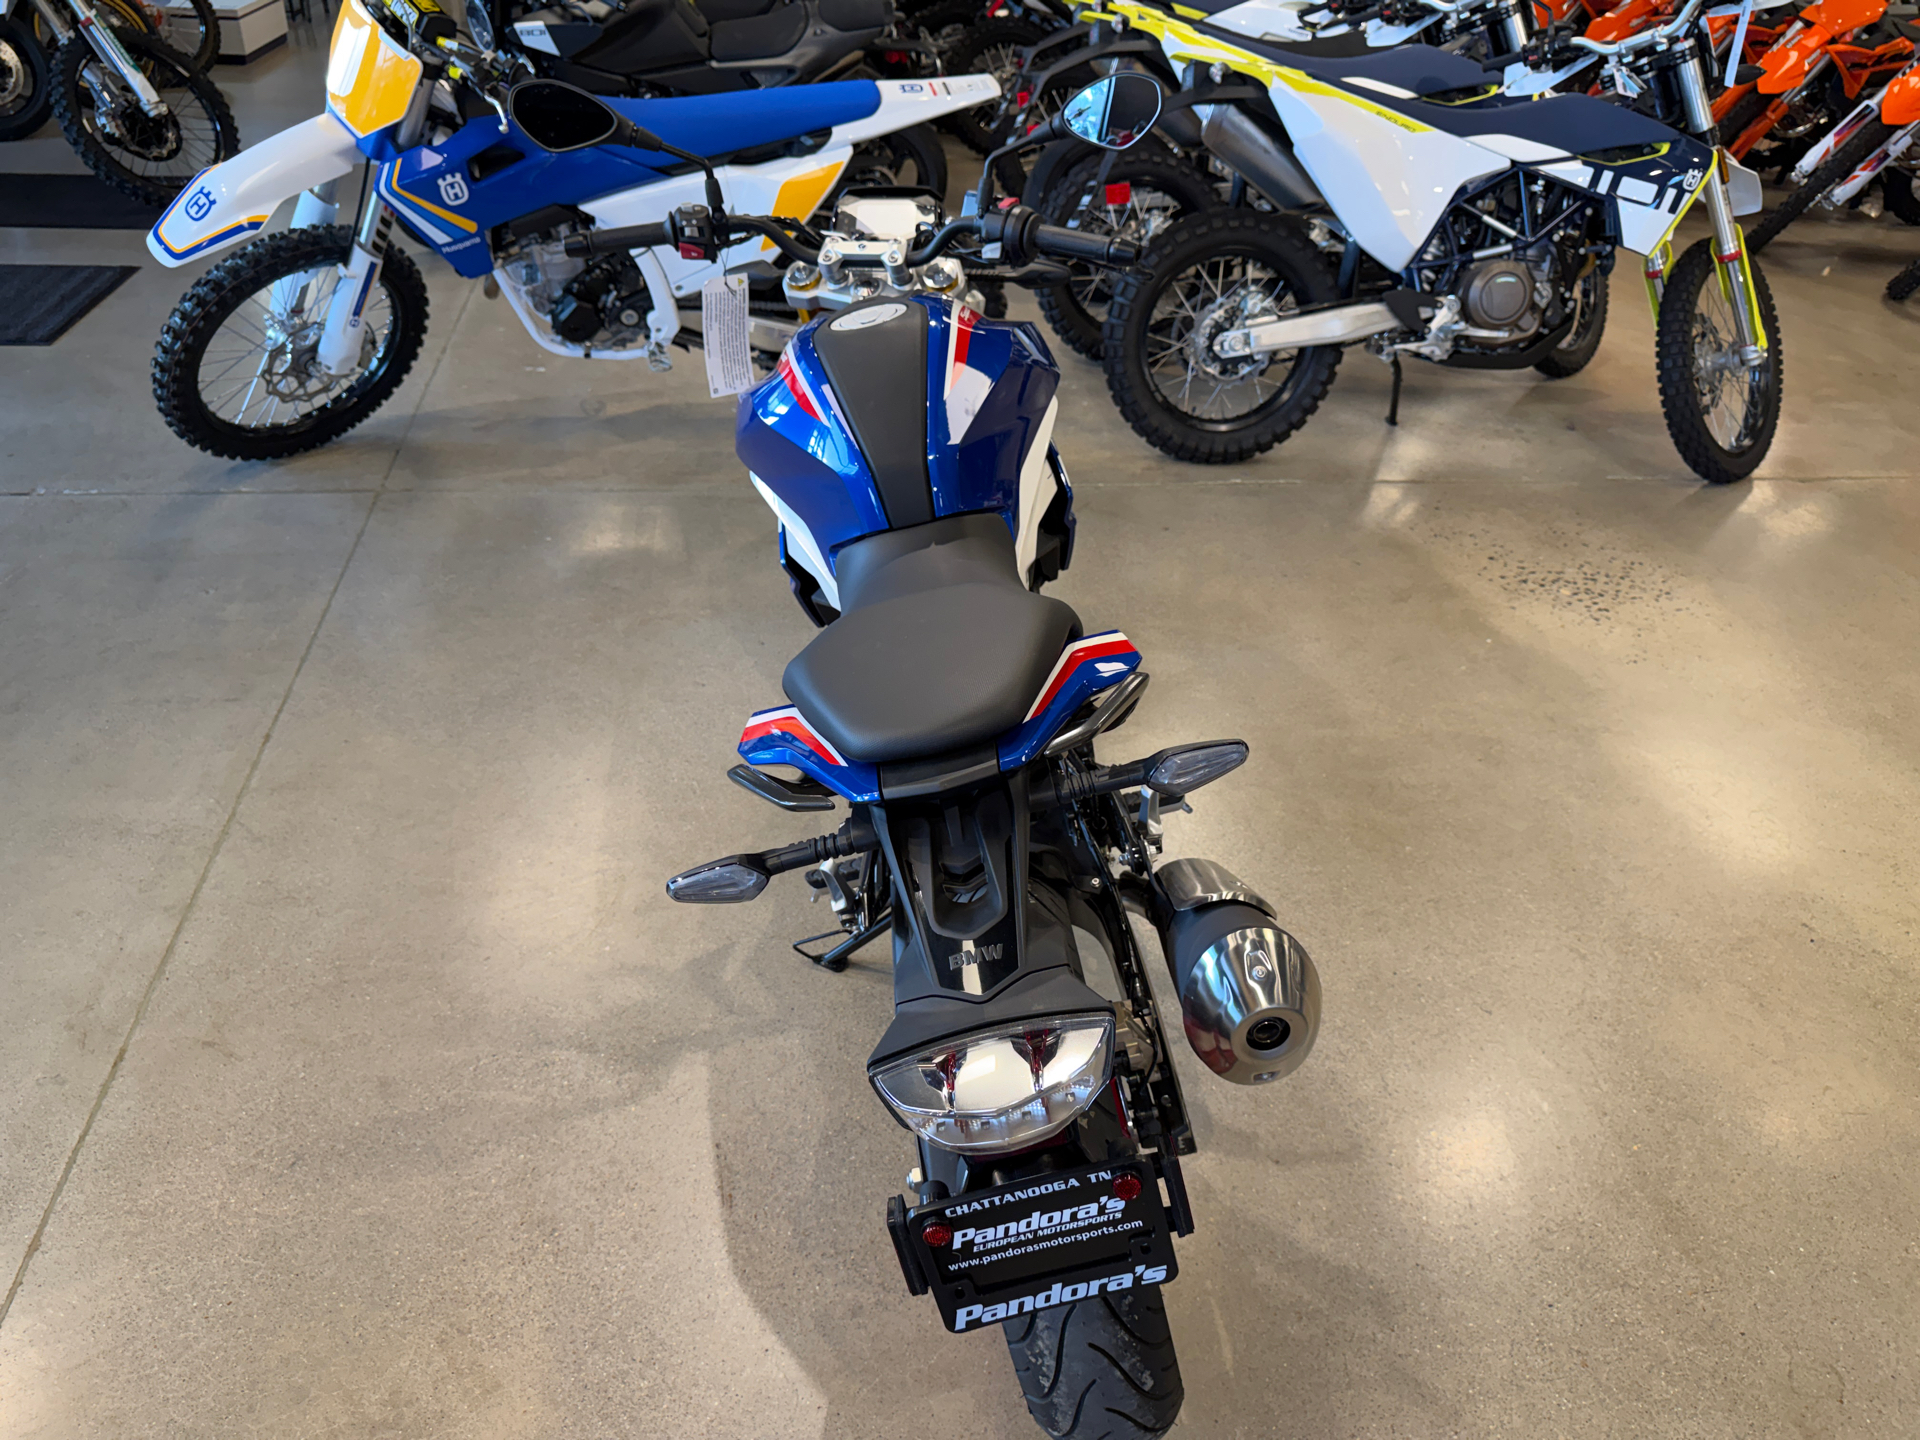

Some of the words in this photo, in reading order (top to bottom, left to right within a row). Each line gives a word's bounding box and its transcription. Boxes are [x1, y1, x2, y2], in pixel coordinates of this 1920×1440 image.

[948, 943, 1003, 971] BMW
[944, 1177, 1081, 1218] CHATTANOOGA
[1087, 1170, 1112, 1184] TN
[947, 1218, 1144, 1271] www.pandorasmotorsports.com
[952, 1195, 1126, 1250] Pandora's
[973, 1231, 1034, 1253] EUROPEAN
[1036, 1211, 1123, 1238] MOTORSPORTS
[953, 1264, 1168, 1332] Pandora's
